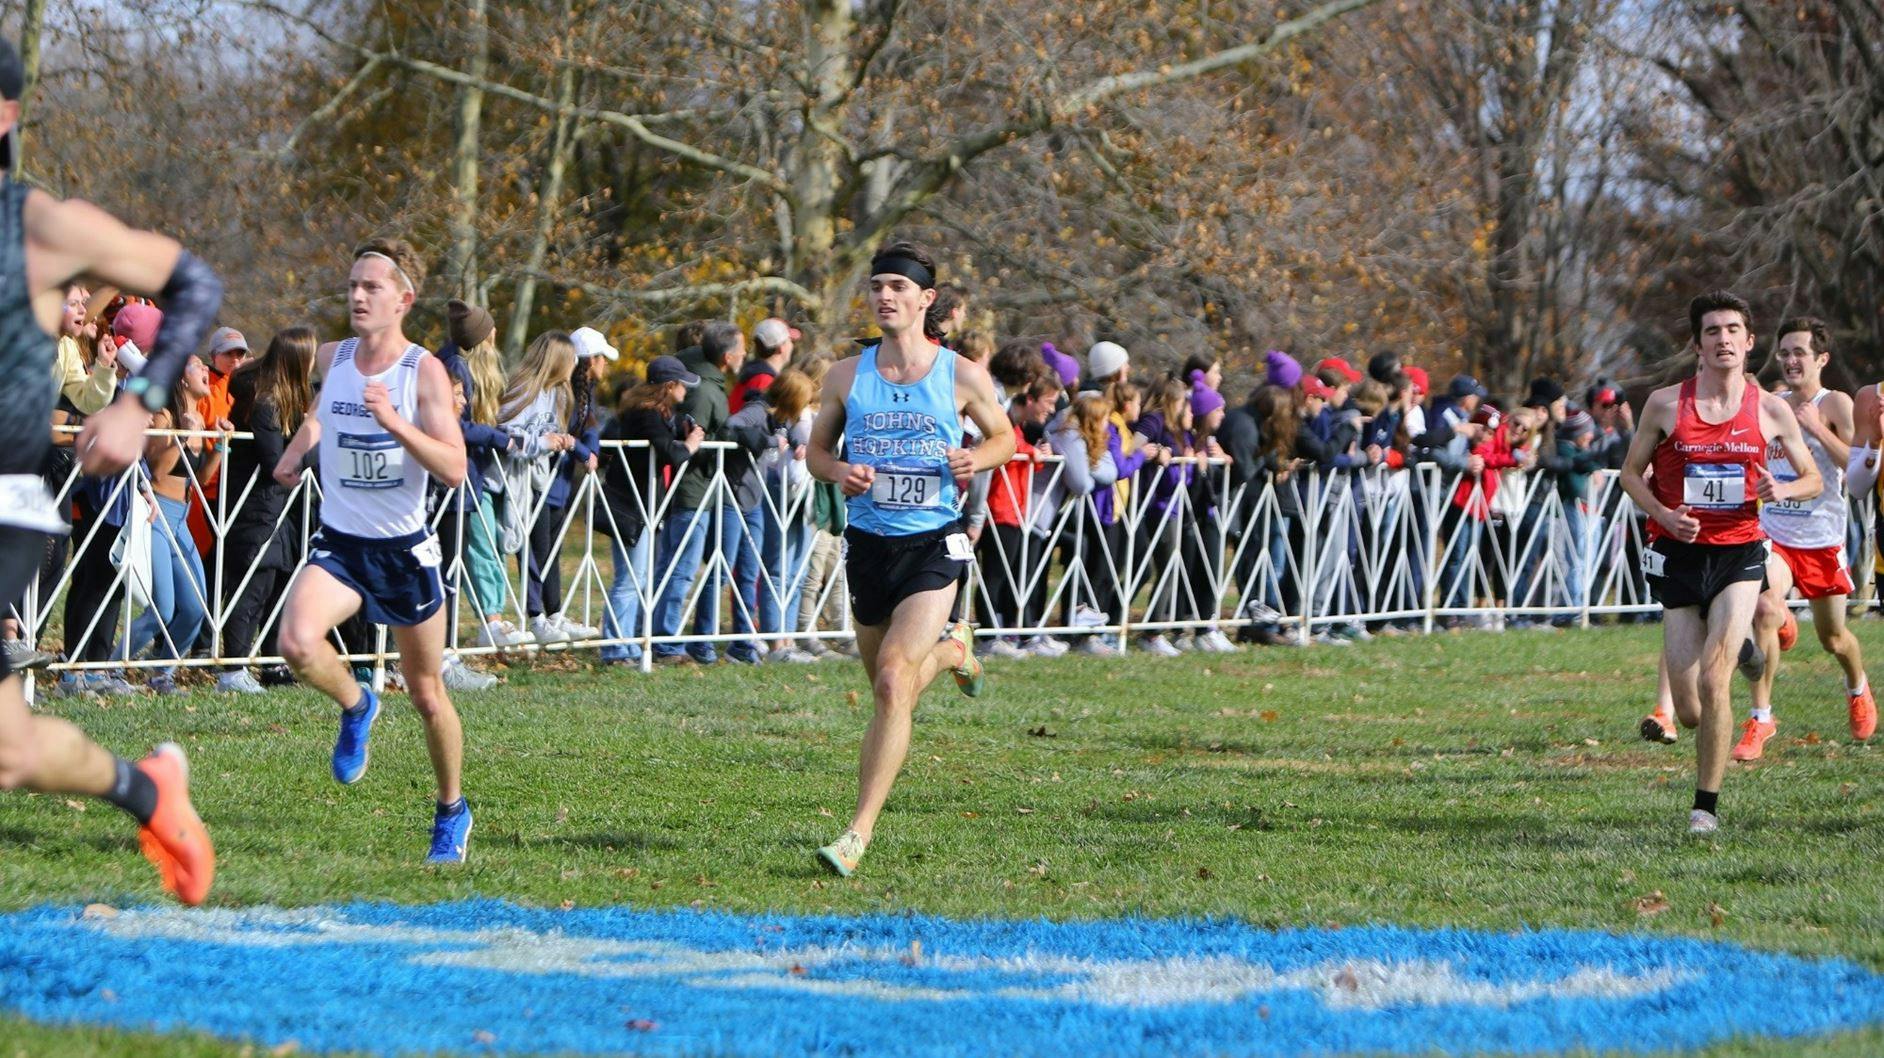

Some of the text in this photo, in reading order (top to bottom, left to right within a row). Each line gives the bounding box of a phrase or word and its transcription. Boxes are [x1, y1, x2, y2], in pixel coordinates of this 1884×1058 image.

[864, 410, 936, 436] JOHNS
[852, 436, 947, 458] HOPKINS
[1674, 440, 1722, 455] Carnegie
[1724, 441, 1760, 454] Mellon
[351, 450, 388, 480] 102
[887, 475, 926, 505] 129
[1703, 480, 1726, 503] 41
[1642, 552, 1653, 570] 41
